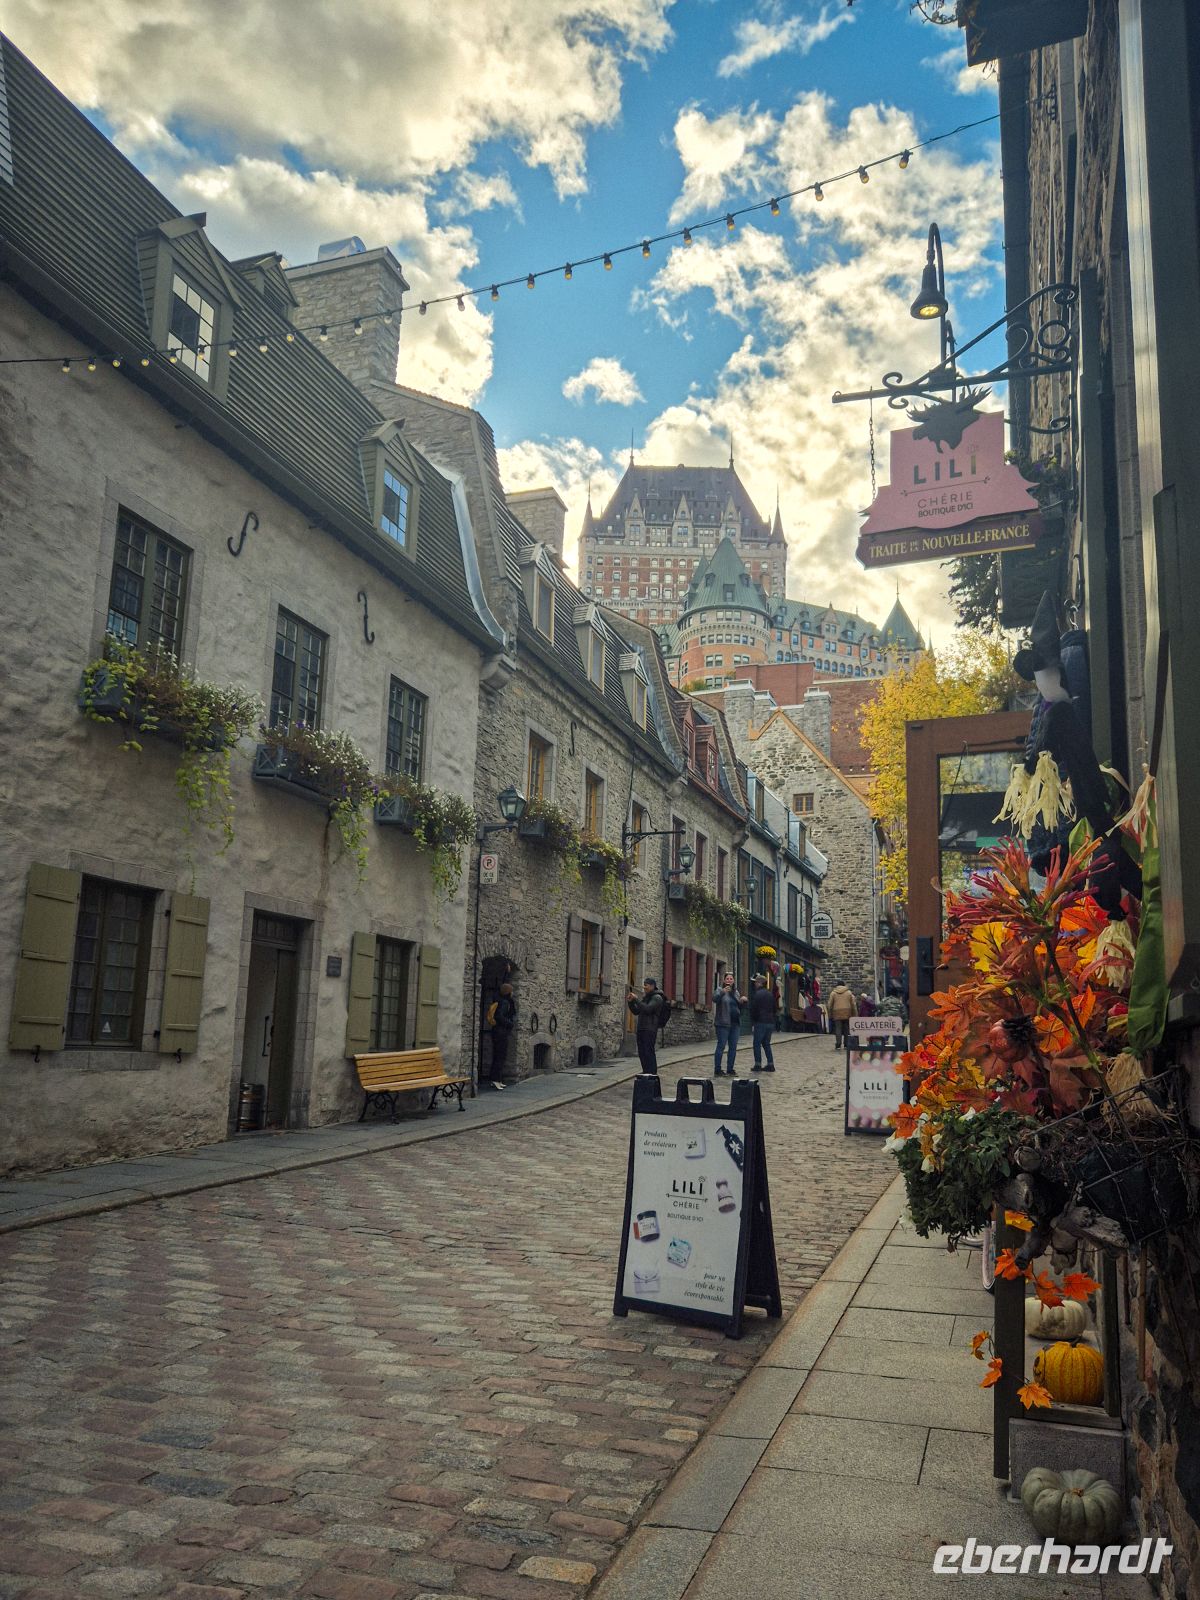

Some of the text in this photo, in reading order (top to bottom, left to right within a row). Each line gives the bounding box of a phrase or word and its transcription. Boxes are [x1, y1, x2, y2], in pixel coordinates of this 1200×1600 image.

[914, 455, 976, 485] LILI
[917, 491, 973, 509] CHÉRIE
[918, 503, 974, 518] BOUTIQUE D'ICI
[869, 541, 907, 558] TRAITE
[922, 524, 1030, 550] NOUVELLE-FRANCE
[854, 1021, 897, 1029] GELATERIE
[863, 1082, 888, 1091] LILI
[672, 1179, 703, 1195] LILI
[672, 1200, 701, 1210] CHÉRIE
